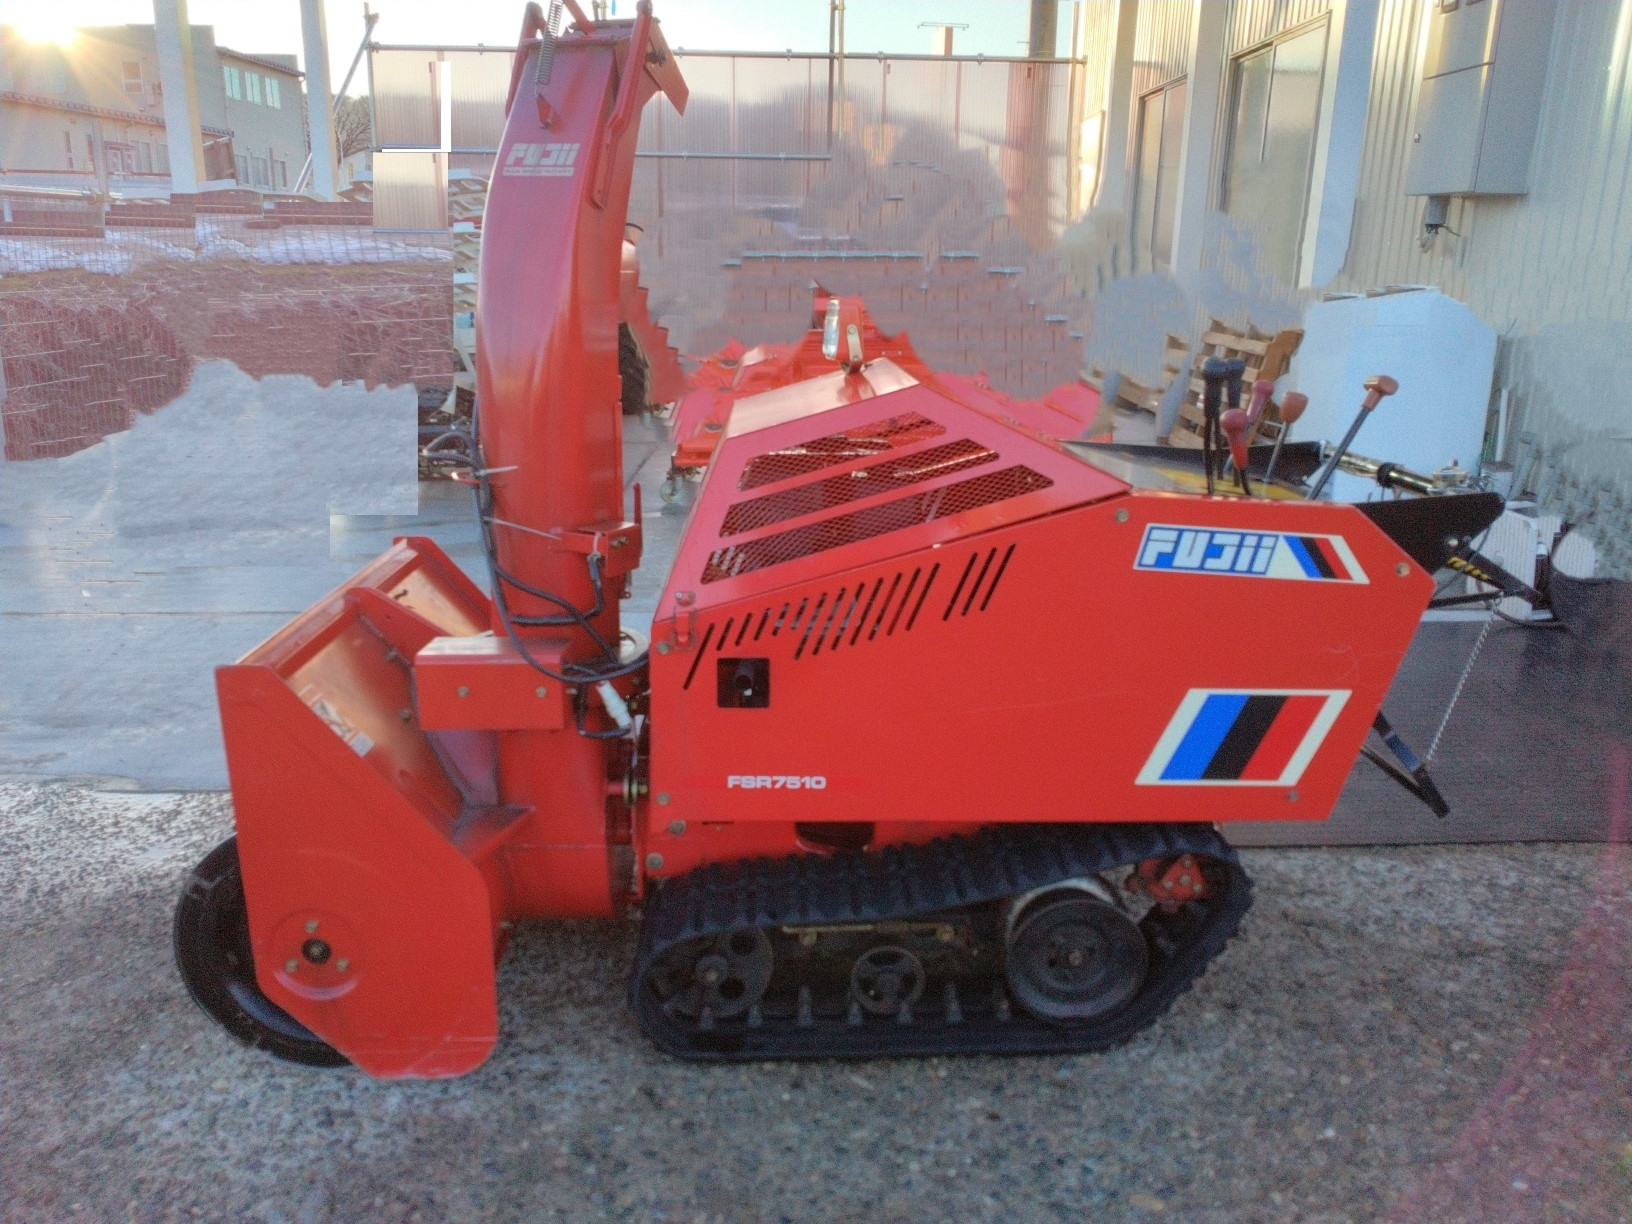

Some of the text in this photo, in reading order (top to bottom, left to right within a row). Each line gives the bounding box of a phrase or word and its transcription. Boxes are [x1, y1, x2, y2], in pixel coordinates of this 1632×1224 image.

[505, 143, 581, 166] FUJII
[1140, 528, 1276, 573] FUJII
[727, 775, 827, 790] FSR7510
